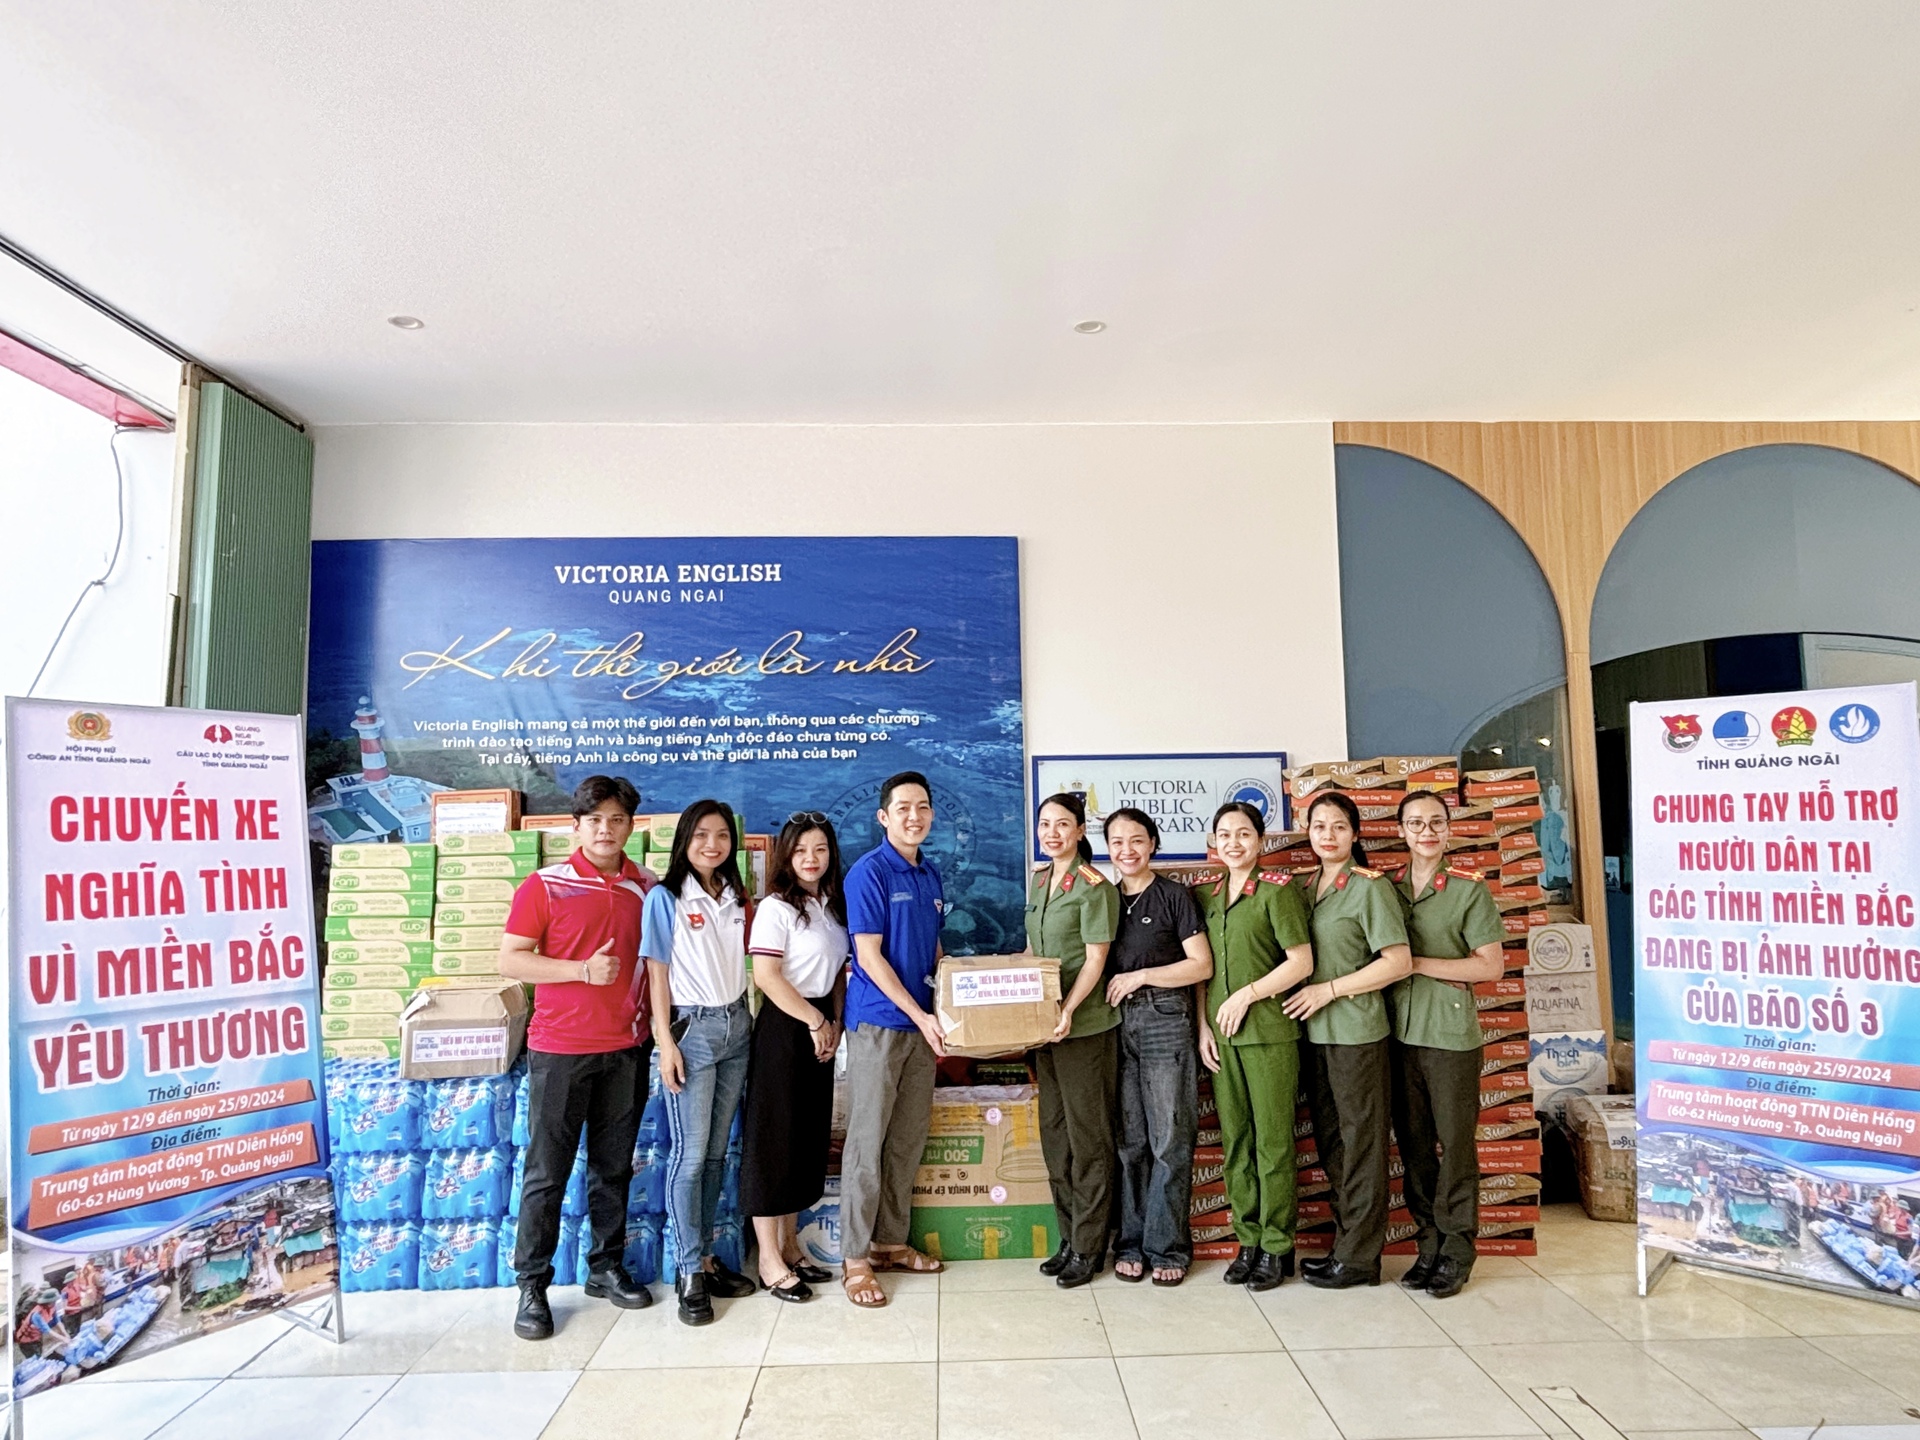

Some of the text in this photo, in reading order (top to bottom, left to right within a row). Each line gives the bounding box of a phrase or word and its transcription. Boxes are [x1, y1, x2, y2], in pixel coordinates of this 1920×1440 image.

[555, 564, 782, 584] VICTORIA ENGLISH
[609, 589, 724, 605] QUANG NGAI
[399, 627, 561, 691] Khi
[622, 647, 751, 700] giới
[758, 630, 825, 675] là
[833, 627, 935, 674] nhà
[235, 725, 261, 733] QUANG
[413, 712, 919, 733] Victoria English mang cả một thế giới đến với bạn, thông qua các chương
[442, 736, 475, 748] trình
[478, 735, 507, 748] đào
[509, 736, 534, 750] tạo
[536, 734, 573, 749] tiếng
[576, 735, 602, 747] Anh
[607, 734, 624, 746] và
[666, 732, 702, 746] tiếng
[704, 732, 733, 744] Anh
[736, 731, 763, 745] độc
[766, 731, 794, 743] đáo
[797, 731, 832, 743] chưa
[834, 729, 867, 744] từng
[869, 729, 892, 741] có.
[478, 746, 857, 767] Tại đây, tiếng Anh là công cụ và thế giới là nhà của bạn
[1696, 752, 1841, 771] TỈNH QUẢNG NGÃI
[1118, 780, 1207, 795] VICTORIA
[50, 781, 280, 842] CHUYẾN XE
[1119, 799, 1193, 814] PUBLIC
[1653, 779, 1899, 828] CHUNG TAY HỖ TRỢ
[1678, 835, 1872, 880] NGƯỜI DÂN TẠI
[45, 860, 289, 922] NGHĨA TÌNH
[1649, 880, 1915, 928] CÁC TỈNH MIỀN BẮC
[29, 922, 305, 1005] VÌ MIỀN BẮC
[1536, 946, 1570, 956] AQUAFINA
[1644, 932, 1920, 984] ĐANG BỊ ẢNH HƯỞNG
[1531, 997, 1582, 1012] AQUAFINA
[1686, 981, 1879, 1036] CỦA BÃO SỐ 3
[34, 1006, 306, 1089] YÊU THƯƠNG
[1743, 1034, 1817, 1053] Thời gian:
[1671, 1047, 1892, 1083] Từ ngày 12/9 đến ngày 25/9/2024
[148, 1080, 221, 1102] Thời gian:
[1746, 1077, 1817, 1096] Địa điểm:
[61, 1088, 285, 1143] Từ ngày 12/9 đến ngày 25/9/2024
[1655, 1085, 1916, 1134] Trung tâm hoạt động TTN Diên Hồng
[151, 1125, 222, 1151] Địa điểm:
[1667, 1105, 1903, 1148] (60-62 Hùng Vương Tp. Quảng Ngãi)
[40, 1127, 304, 1199] Trung tâm hoạt động TTN Diên Hồng
[944, 1150, 970, 1162] 500
[56, 1149, 295, 1217] (60-62 Hùng Vương Tp. Quảng Ngãi)
